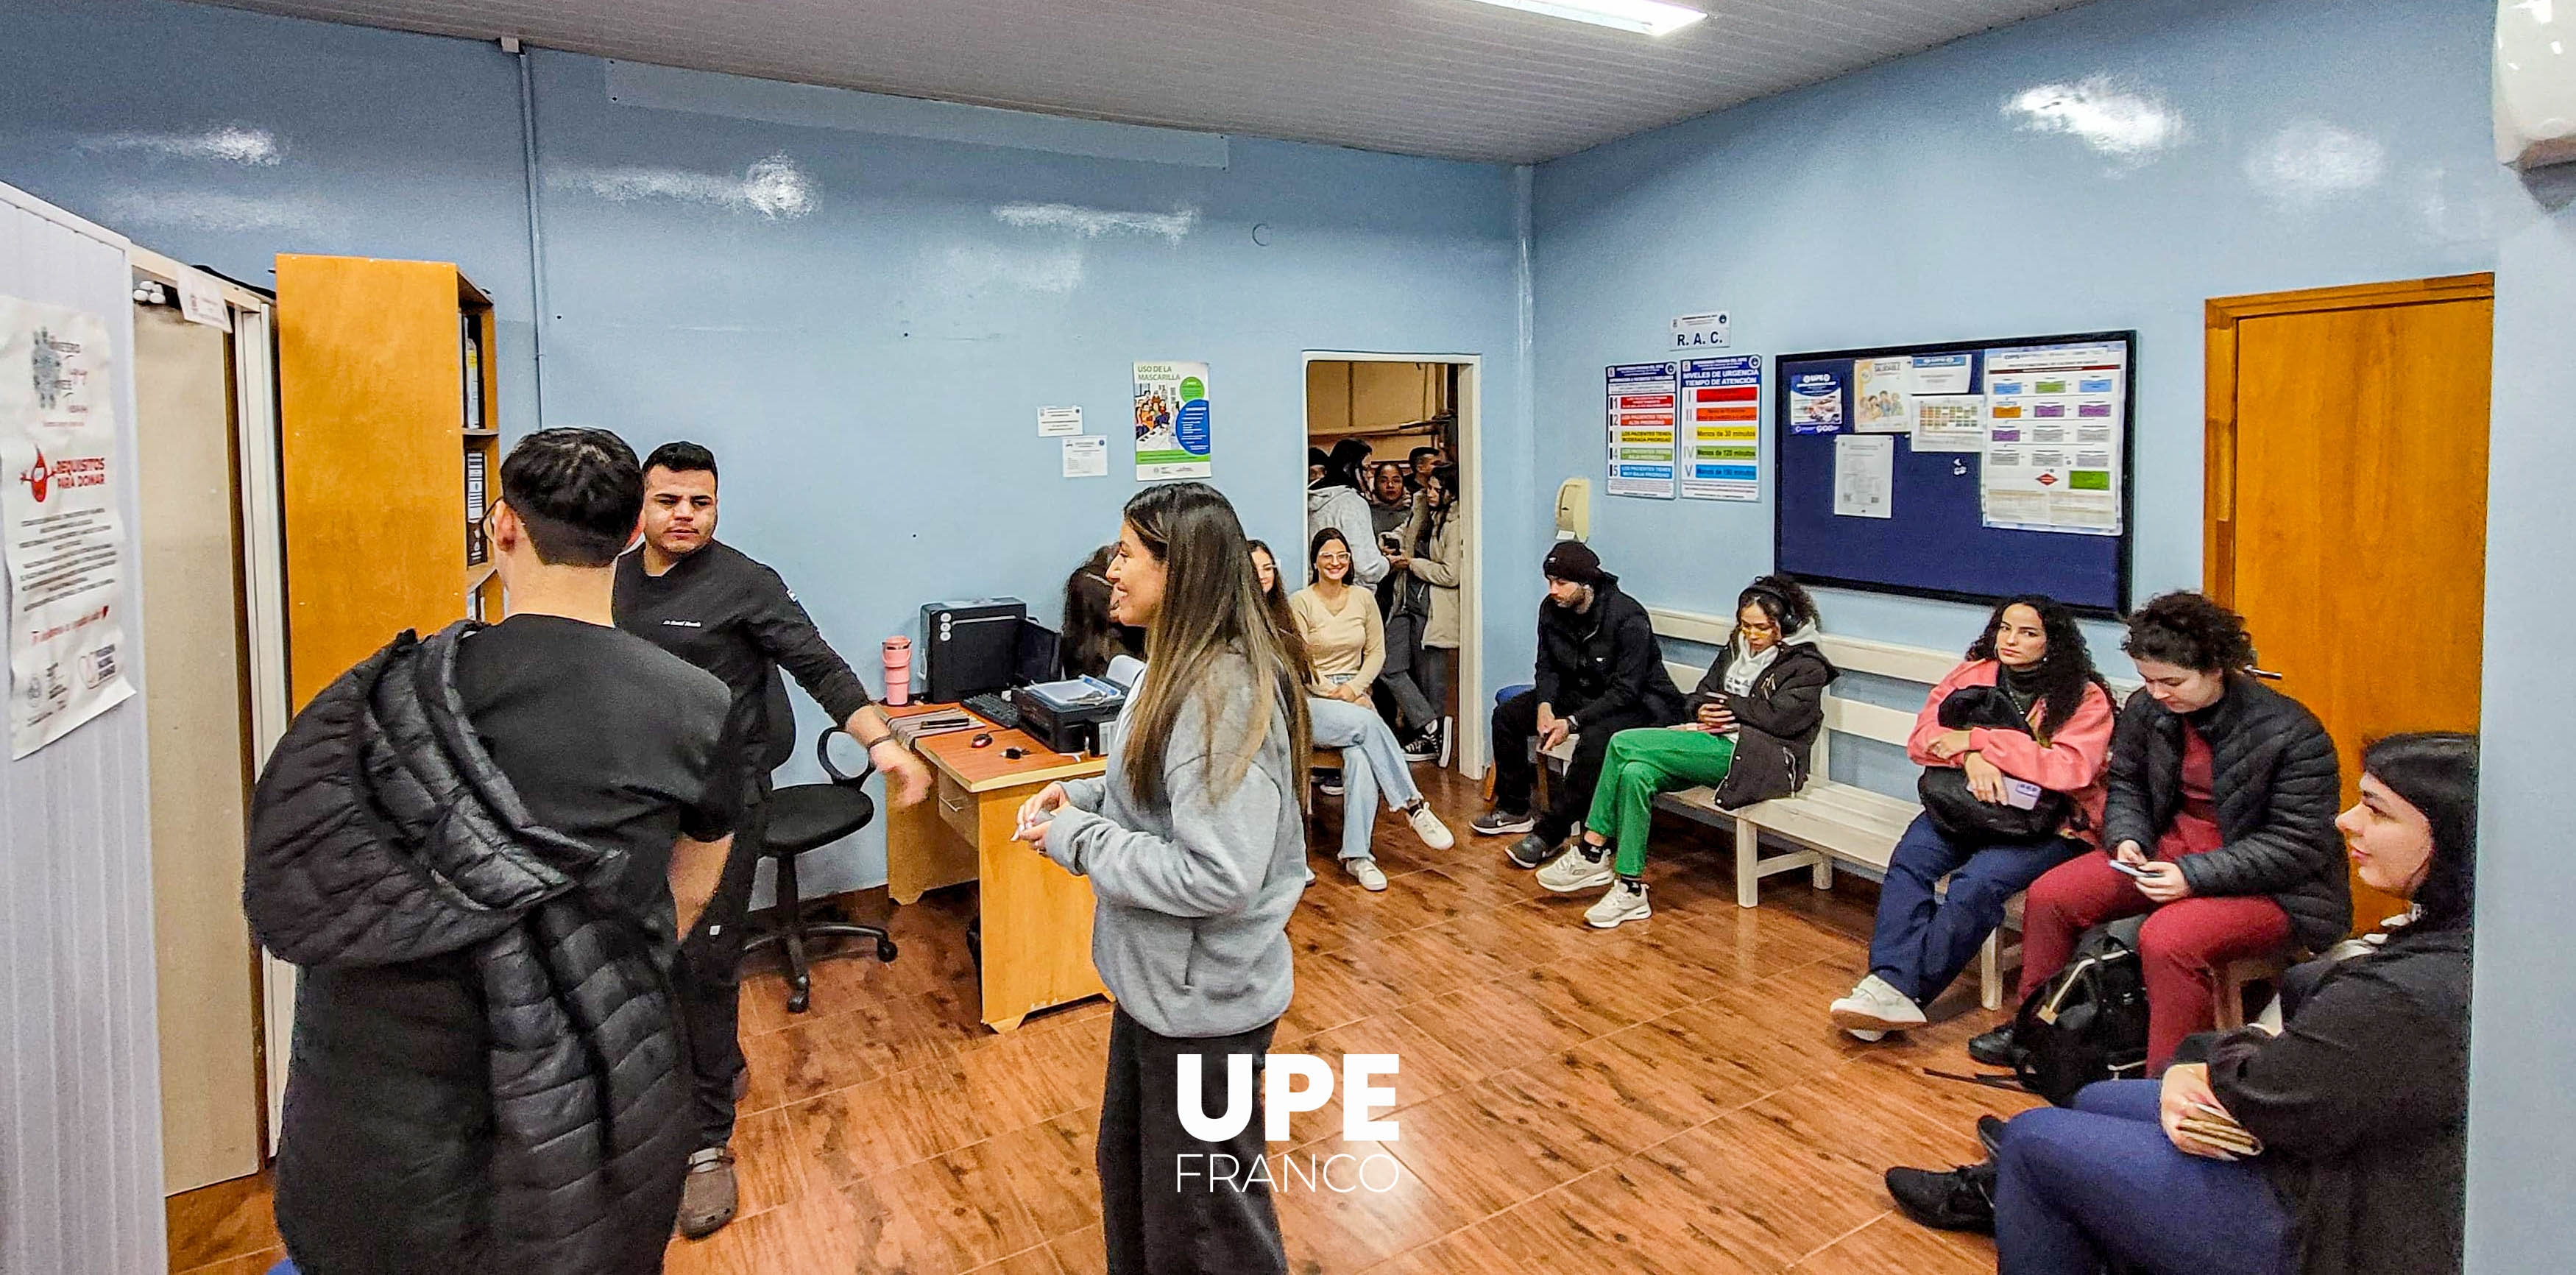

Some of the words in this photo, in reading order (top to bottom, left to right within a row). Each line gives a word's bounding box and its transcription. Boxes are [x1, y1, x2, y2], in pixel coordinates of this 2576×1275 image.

[1677, 334, 1689, 346] R.
[1694, 332, 1705, 345] A.
[1710, 331, 1723, 344] C.
[1683, 371, 1710, 379] NIVELES
[1722, 369, 1759, 377] URGENCIA
[1722, 376, 1757, 384] ATENCIÓN
[1613, 414, 1618, 425] 2
[1684, 445, 1694, 459] IV
[57, 457, 105, 474] REQUISITOS
[1613, 465, 1618, 476] 5
[1685, 465, 1693, 477] V
[77, 473, 105, 487] DONAR
